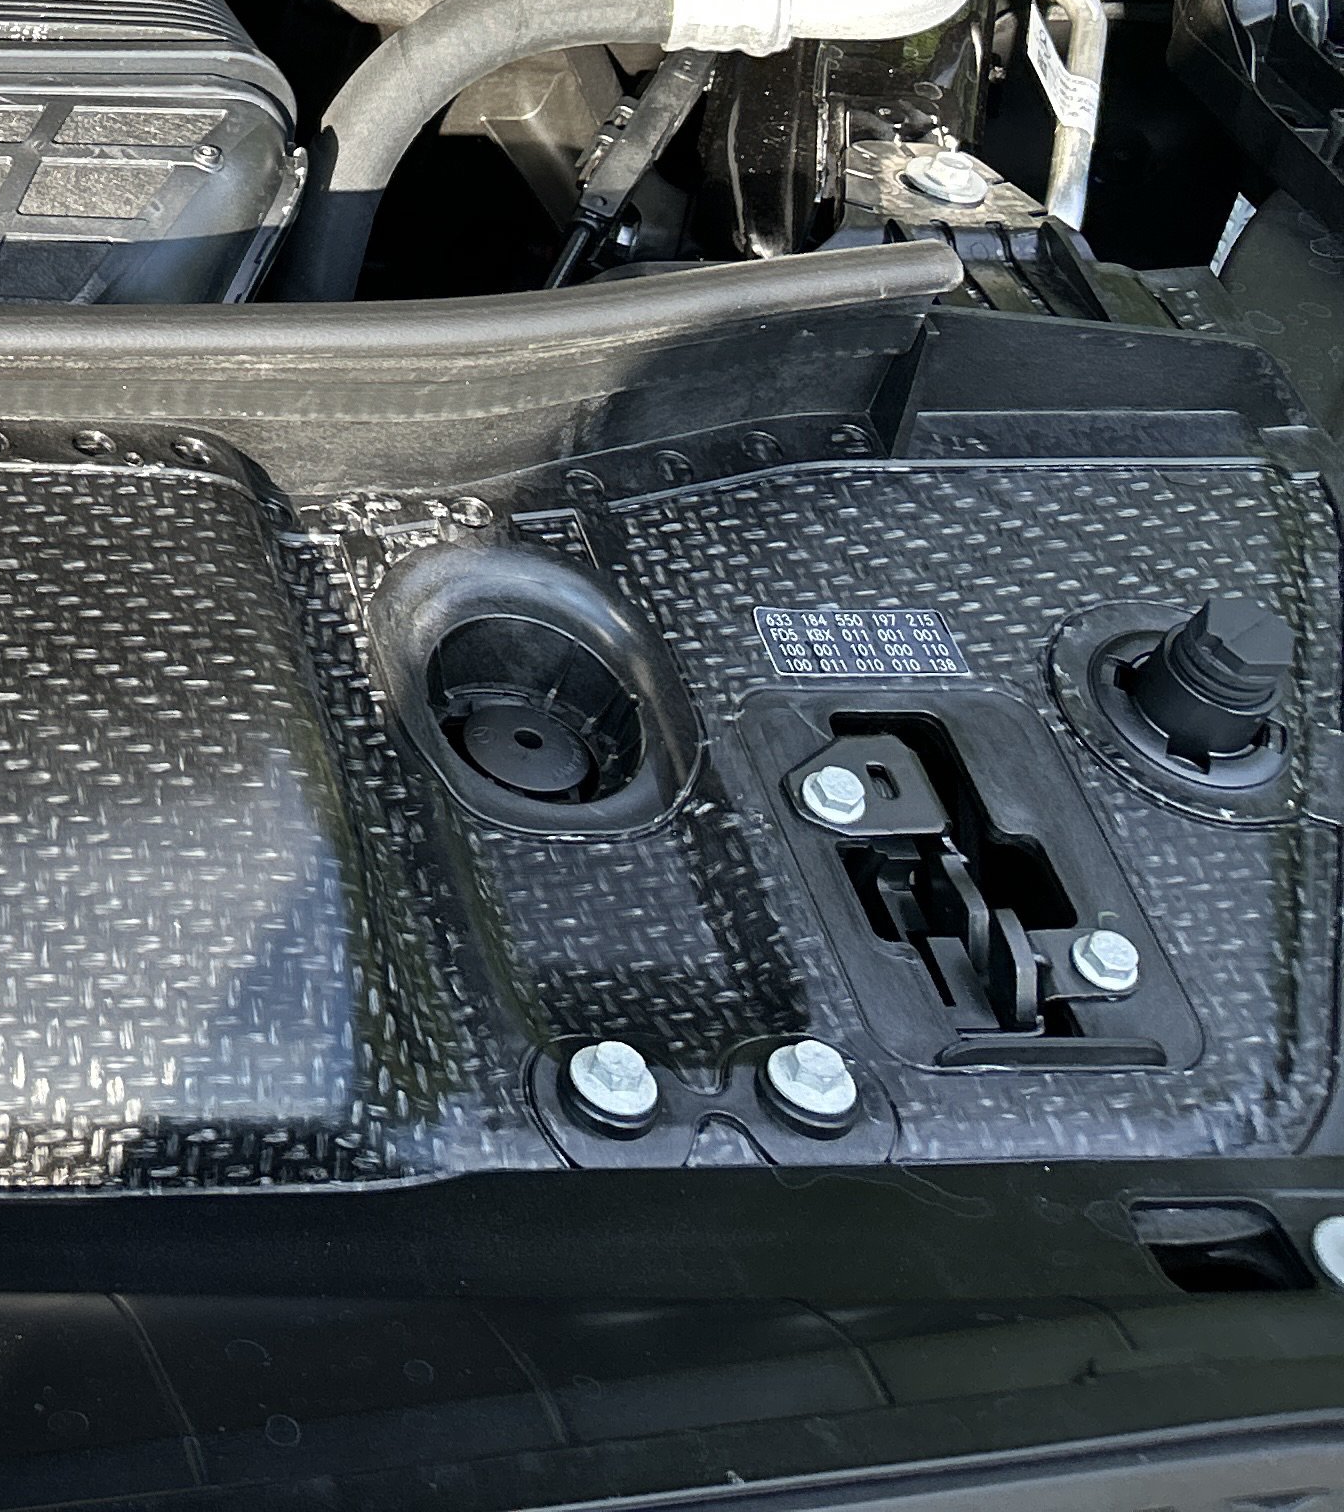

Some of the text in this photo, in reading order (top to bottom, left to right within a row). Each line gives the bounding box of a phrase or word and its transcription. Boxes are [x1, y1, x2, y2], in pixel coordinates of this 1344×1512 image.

[766, 613, 934, 627] 633 184 550 197 215
[769, 628, 798, 642] FD5
[841, 628, 869, 642] 011
[877, 628, 905, 642] 001
[913, 628, 941, 642] 001
[779, 643, 949, 657] 100 001 101 000 110
[785, 658, 957, 672] 100 011 010 010 138
